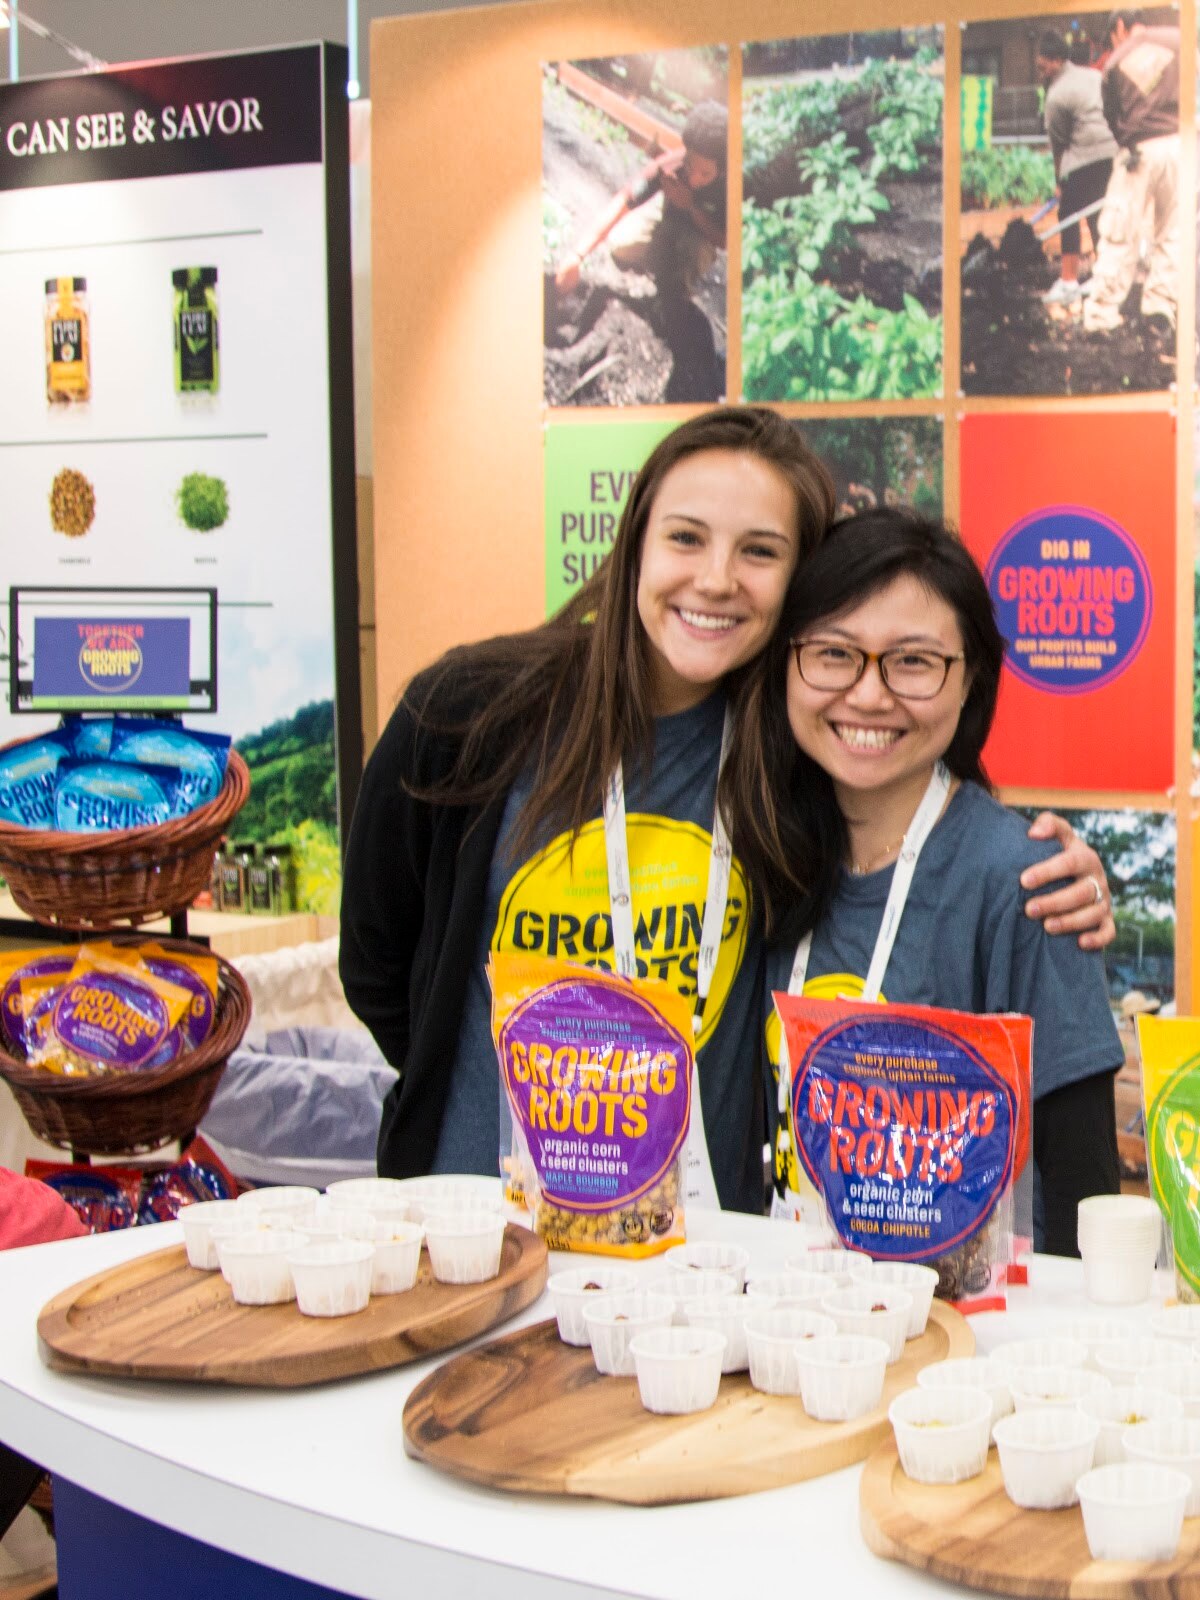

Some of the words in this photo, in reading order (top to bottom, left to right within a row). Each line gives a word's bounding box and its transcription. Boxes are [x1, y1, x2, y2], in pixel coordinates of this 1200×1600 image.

[7, 117, 70, 157] CAN
[75, 112, 127, 150] SEE
[132, 109, 156, 143] &
[161, 97, 264, 141] SAVOR
[1040, 540, 1070, 559] DIG
[1073, 540, 1090, 560] IN
[998, 566, 1135, 603] GROWING
[1017, 601, 1116, 637] ROOTS
[70, 985, 160, 1039] GROWING
[73, 1003, 142, 1047] ROOTS
[510, 1040, 678, 1098] GROWING
[843, 1064, 887, 1080] supports
[889, 1068, 922, 1083] urban
[855, 1052, 883, 1068] every
[886, 1055, 938, 1072] purchase
[529, 1086, 649, 1139] ROOTS
[808, 1077, 997, 1138] GROWING
[544, 1138, 589, 1157] organic
[591, 1142, 621, 1159] corn
[829, 1124, 964, 1184] ROOTS
[545, 1170, 573, 1184] MAPLE
[575, 1173, 619, 1189] BOURBON
[548, 1155, 576, 1171] seed
[578, 1157, 629, 1176] clusters
[850, 1182, 900, 1204] organic
[842, 1198, 851, 1214] &
[853, 1199, 884, 1219] seed
[886, 1202, 942, 1223] clusters
[850, 1219, 880, 1234] COCOA
[882, 1222, 931, 1238] CHIPOTLE
